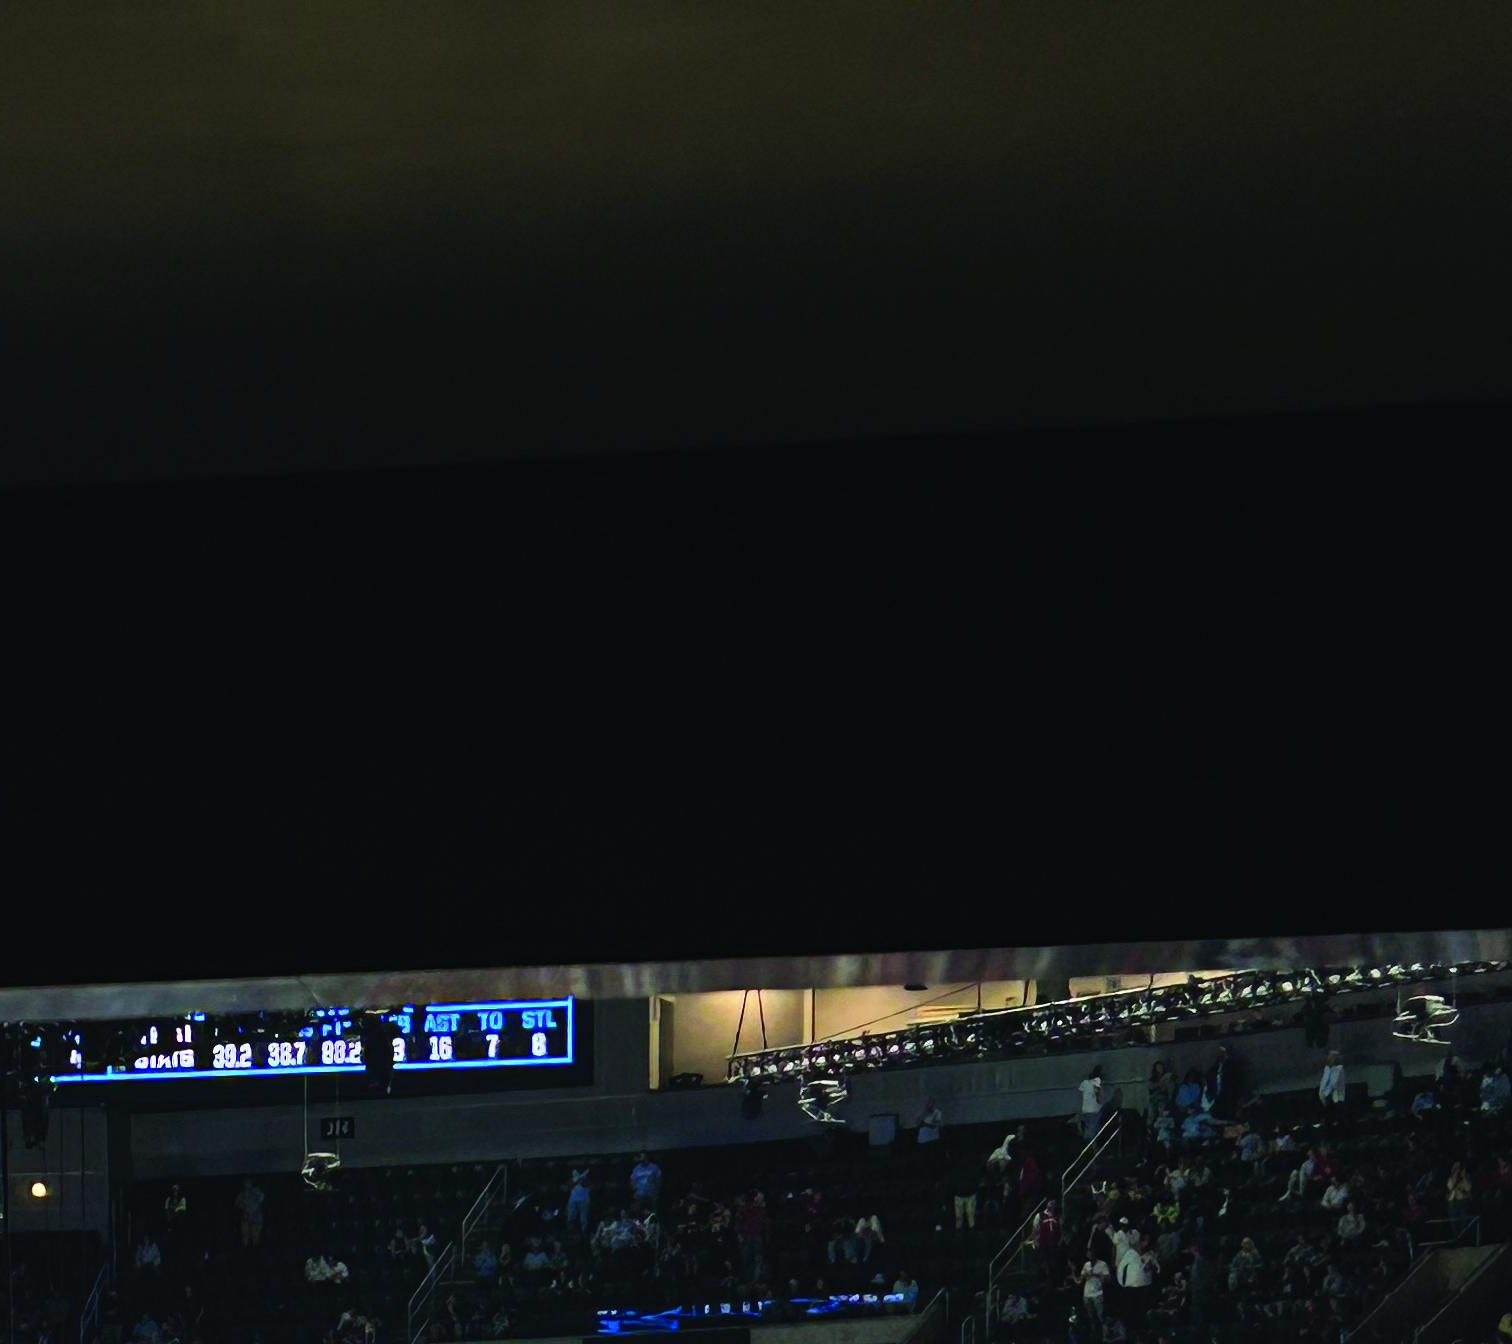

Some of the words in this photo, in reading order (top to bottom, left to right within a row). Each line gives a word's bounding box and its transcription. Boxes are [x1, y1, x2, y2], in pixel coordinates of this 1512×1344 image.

[424, 1013, 460, 1032] AST
[477, 1011, 503, 1031] TO
[522, 1009, 557, 1029] STL
[429, 1036, 453, 1061] 16
[486, 1034, 500, 1058] 7
[532, 1032, 547, 1057] 8
